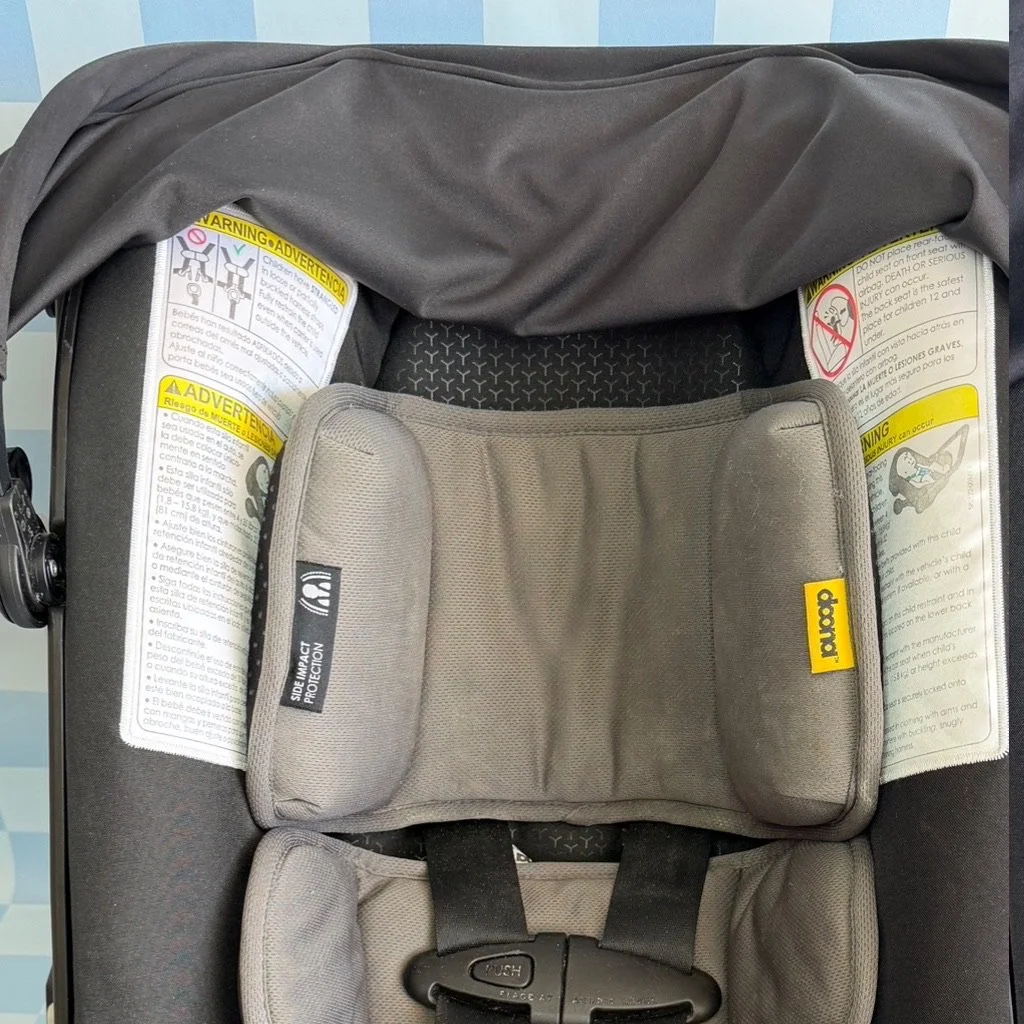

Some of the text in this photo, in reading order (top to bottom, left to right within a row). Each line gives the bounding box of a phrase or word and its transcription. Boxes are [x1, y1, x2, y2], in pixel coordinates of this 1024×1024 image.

[887, 244, 912, 260] place
[928, 244, 948, 257] seat
[275, 241, 346, 299] ADVERTENCIA
[885, 266, 912, 284] DEATH
[913, 261, 927, 272] OR
[928, 251, 968, 268] SERIOUS
[884, 284, 901, 297] can
[894, 290, 911, 305] seat
[920, 280, 936, 293] the
[936, 274, 964, 288] safest
[929, 292, 941, 302] 12
[941, 288, 961, 299] and
[895, 350, 927, 371] LESIONES
[922, 357, 942, 370] para
[943, 353, 955, 362] los
[184, 383, 277, 448] ADVERTENCIA
[861, 421, 890, 452] NING
[817, 588, 838, 658] doona
[290, 641, 311, 702] SIDE IMPACT
[303, 642, 324, 704] PROTECTION
